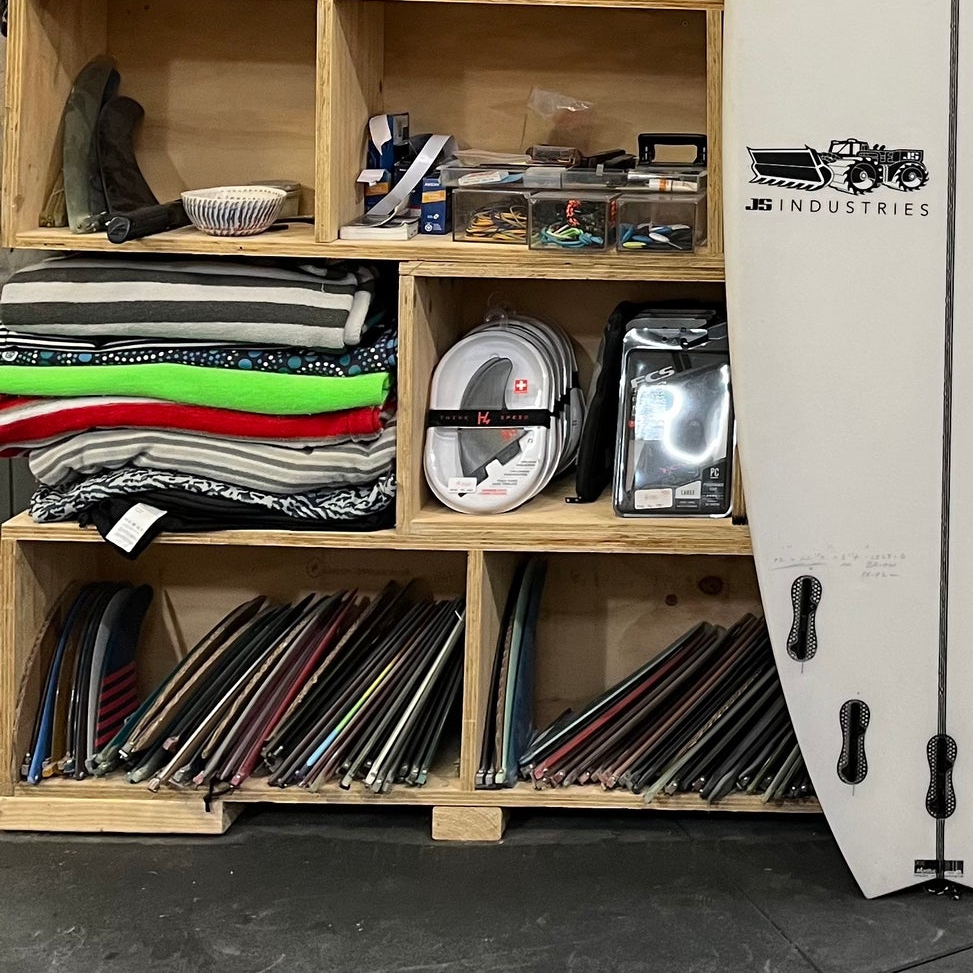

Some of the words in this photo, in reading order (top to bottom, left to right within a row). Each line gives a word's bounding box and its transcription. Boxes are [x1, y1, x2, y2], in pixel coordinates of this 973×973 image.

[902, 151, 919, 161] JS
[744, 198, 773, 212] JS
[779, 199, 929, 217] INDUSTRIES
[629, 365, 676, 389] FCS
[709, 467, 720, 477] PC
